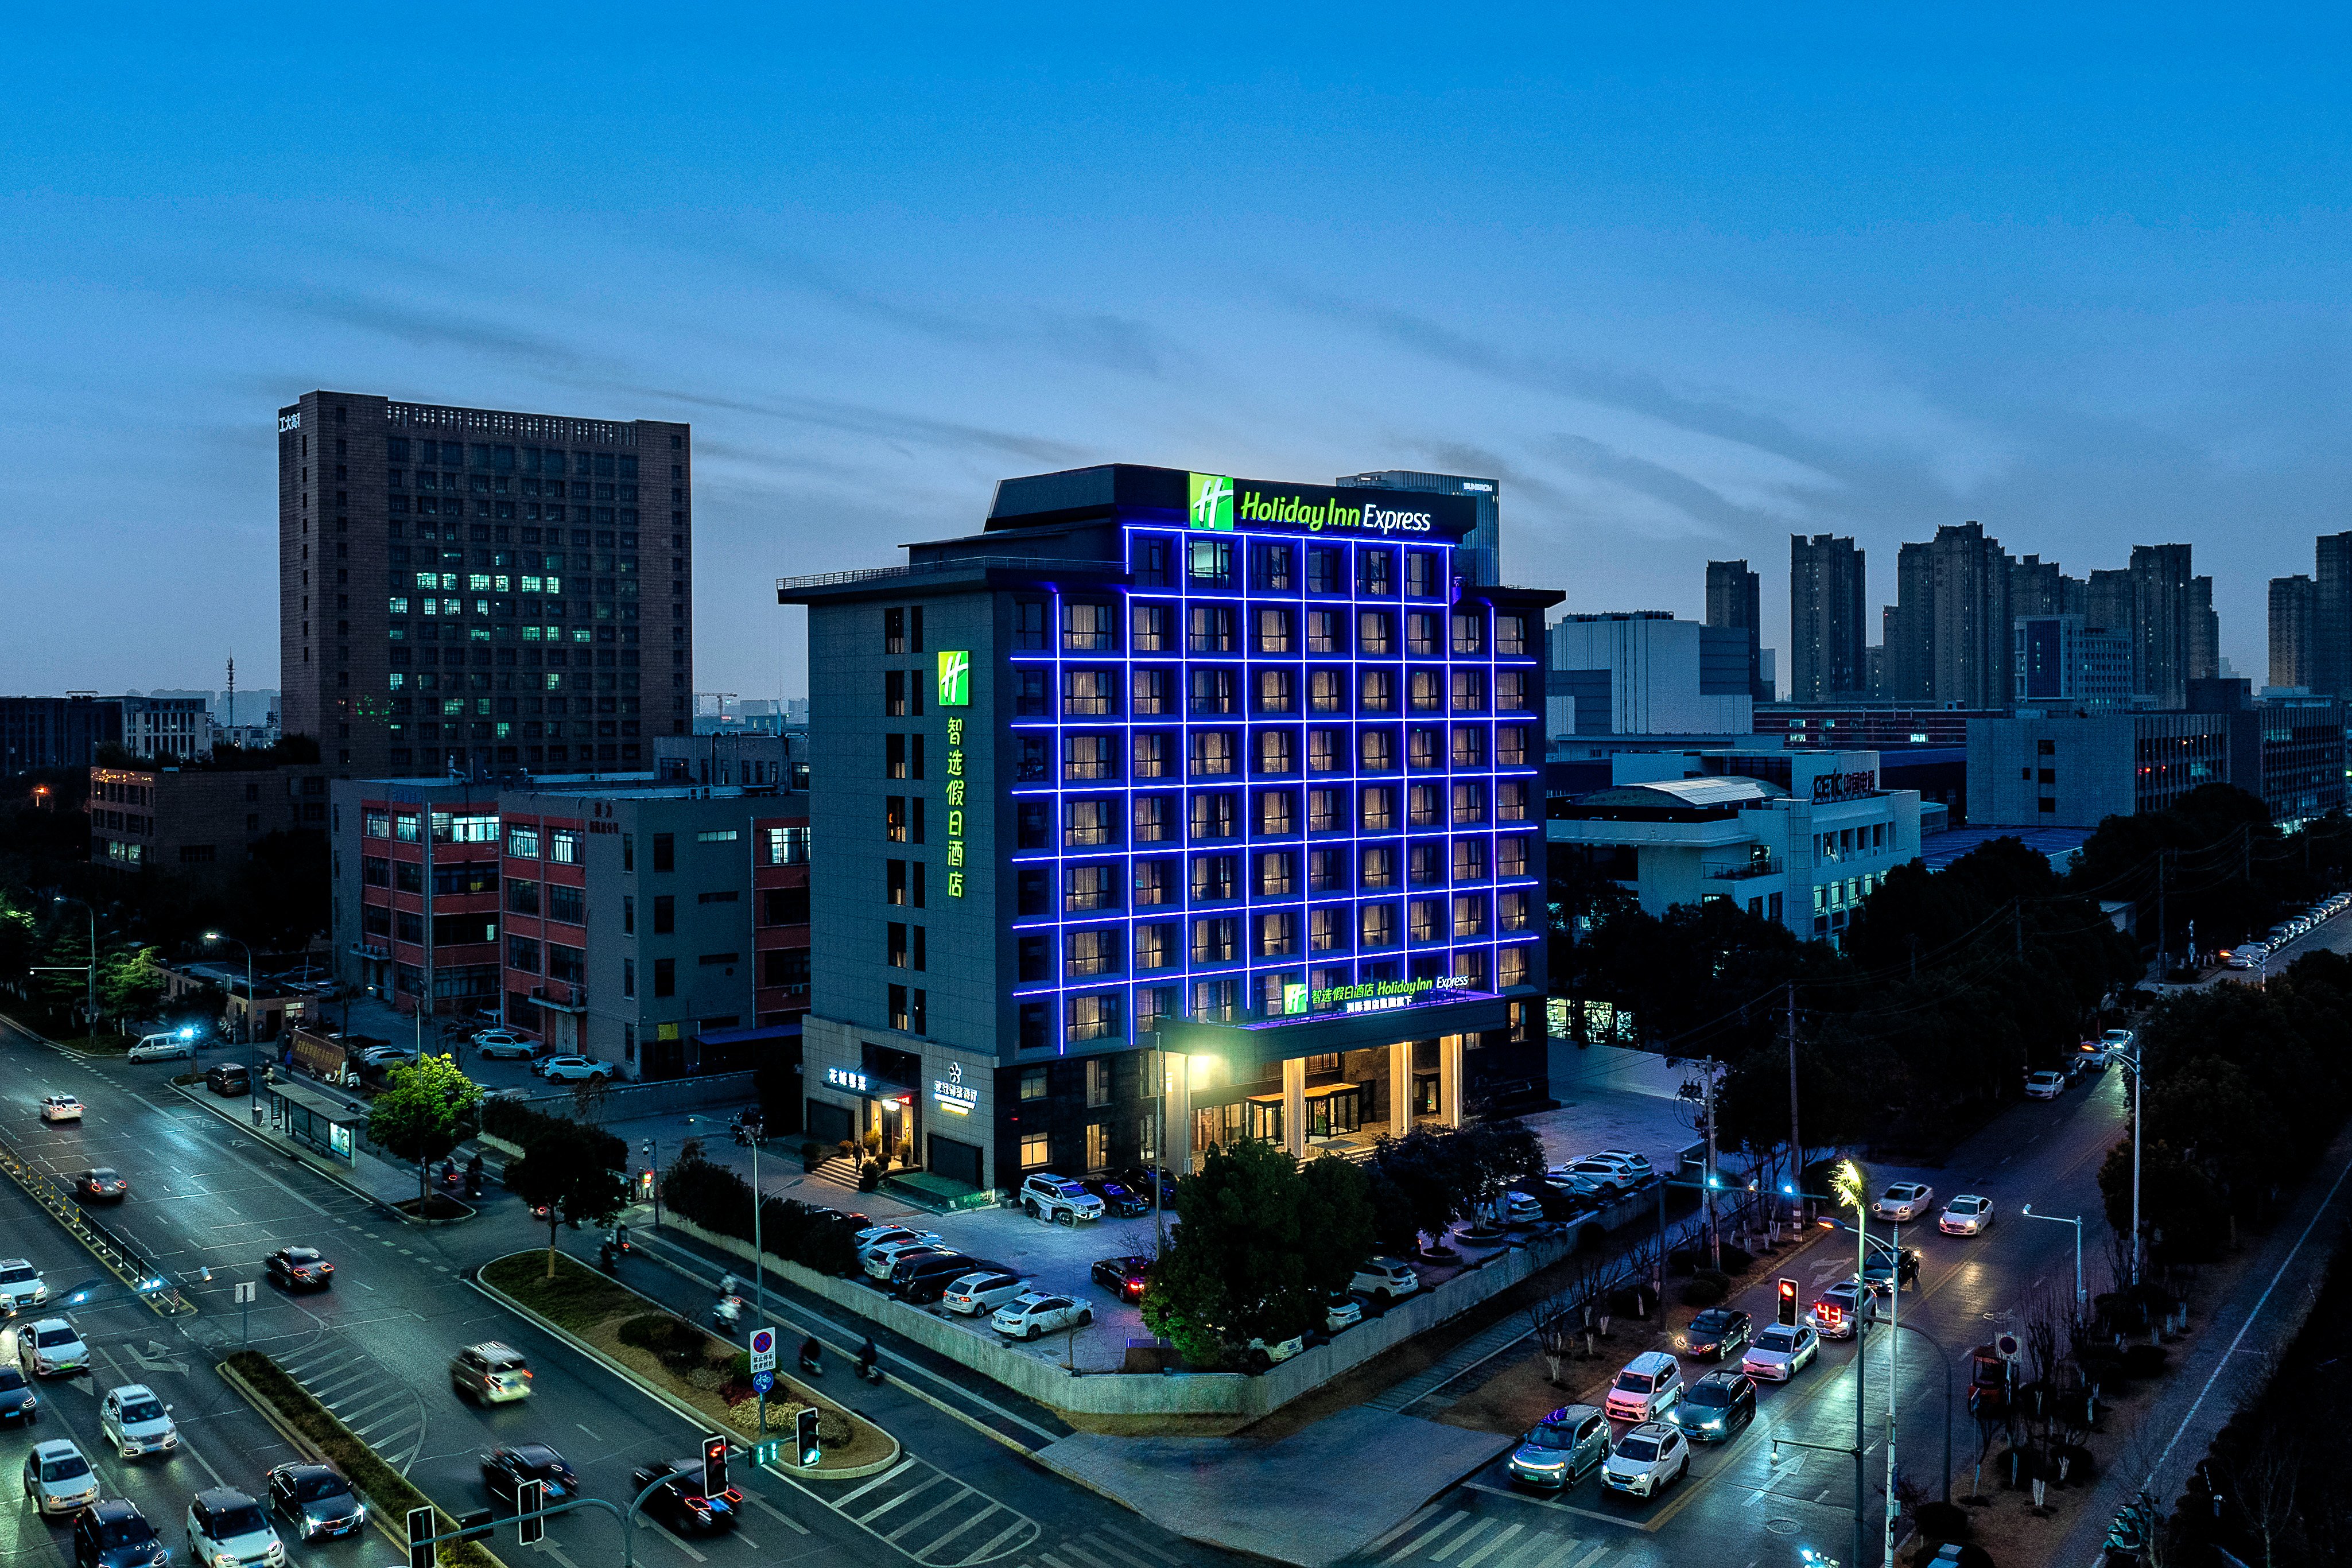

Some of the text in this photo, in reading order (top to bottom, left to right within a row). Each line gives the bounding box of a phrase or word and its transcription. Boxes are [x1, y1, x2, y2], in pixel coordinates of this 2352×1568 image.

[1240, 491, 1431, 534] Holiday Inn Express
[946, 716, 964, 898] 智选假日酒店
[1311, 976, 1469, 1004] 智选假日酒店 Holiday Inn Express
[1817, 1303, 1841, 1324] 43
[753, 1354, 773, 1364] 禁止停车
